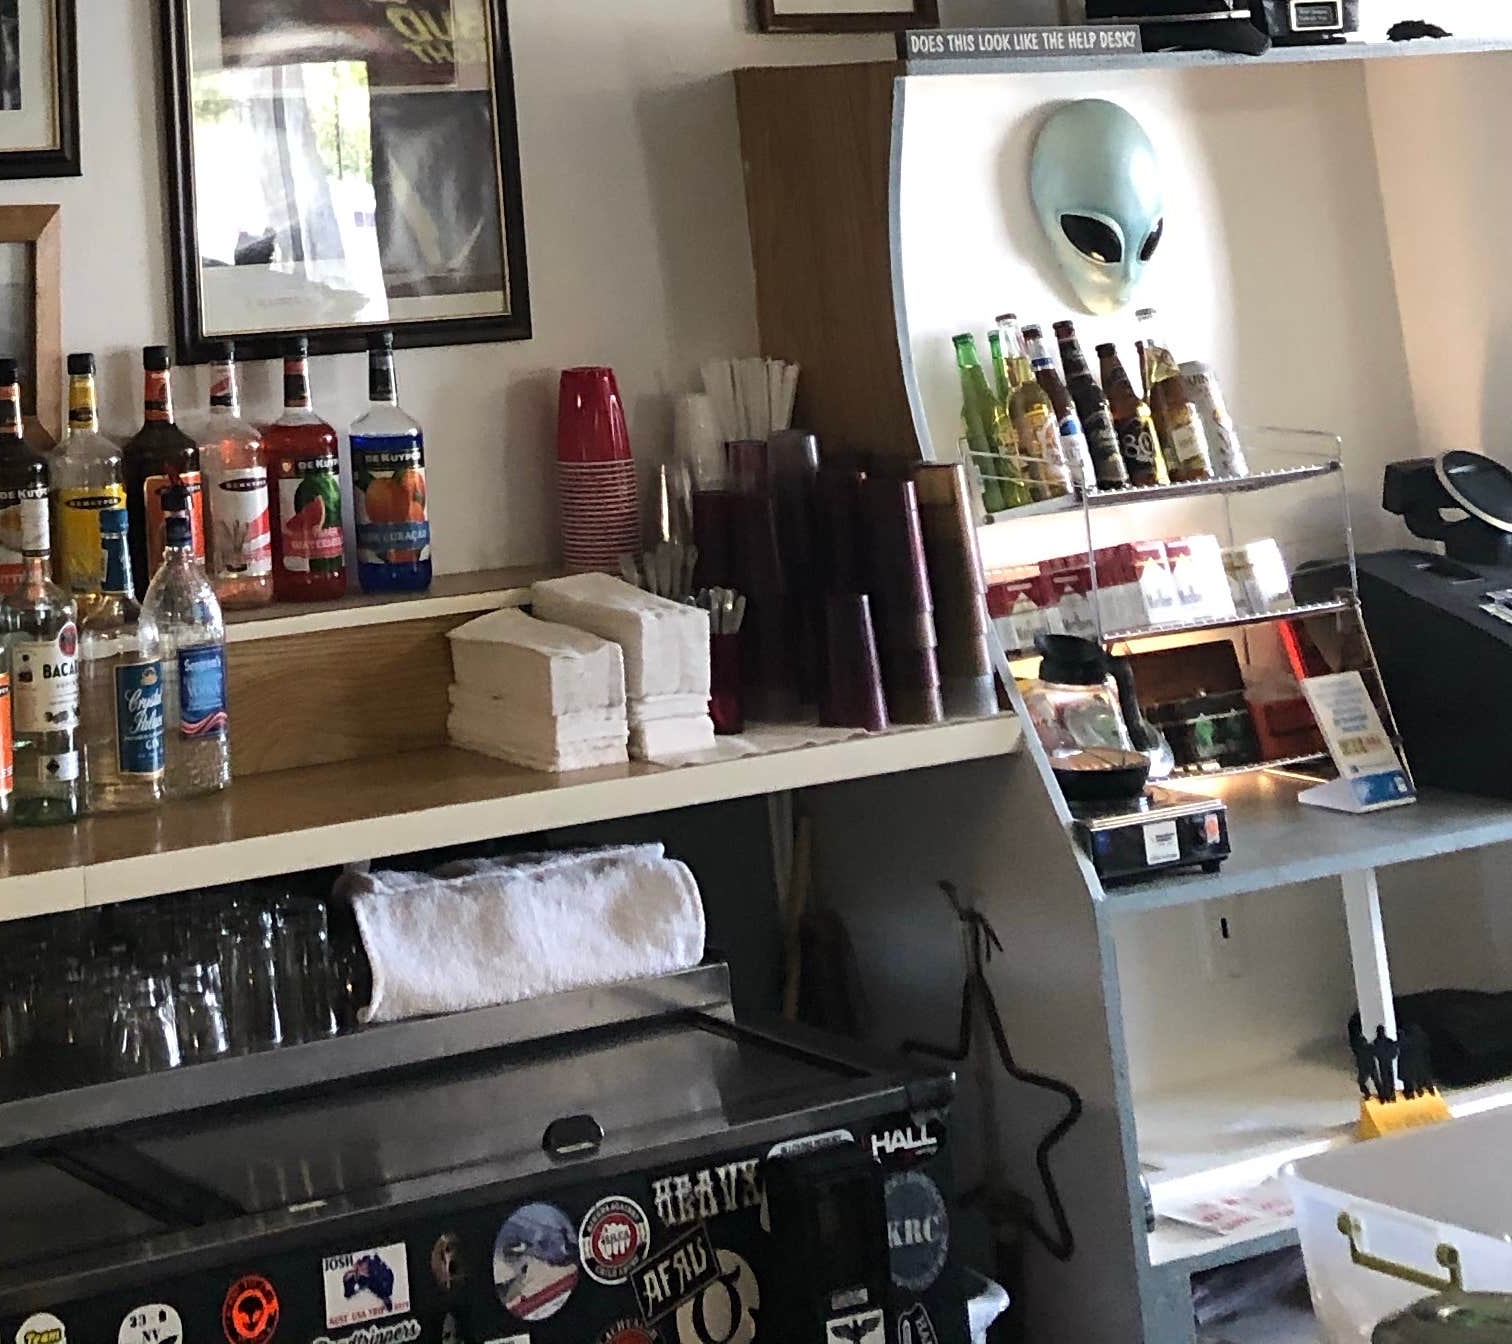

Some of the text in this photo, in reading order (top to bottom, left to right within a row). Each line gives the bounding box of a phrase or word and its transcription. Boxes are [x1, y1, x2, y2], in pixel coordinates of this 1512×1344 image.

[911, 27, 1137, 53] DOES THIS LOOK LIKE THE HELP DESK?
[871, 1126, 937, 1163] HALL
[324, 1254, 354, 1272] JOSH
